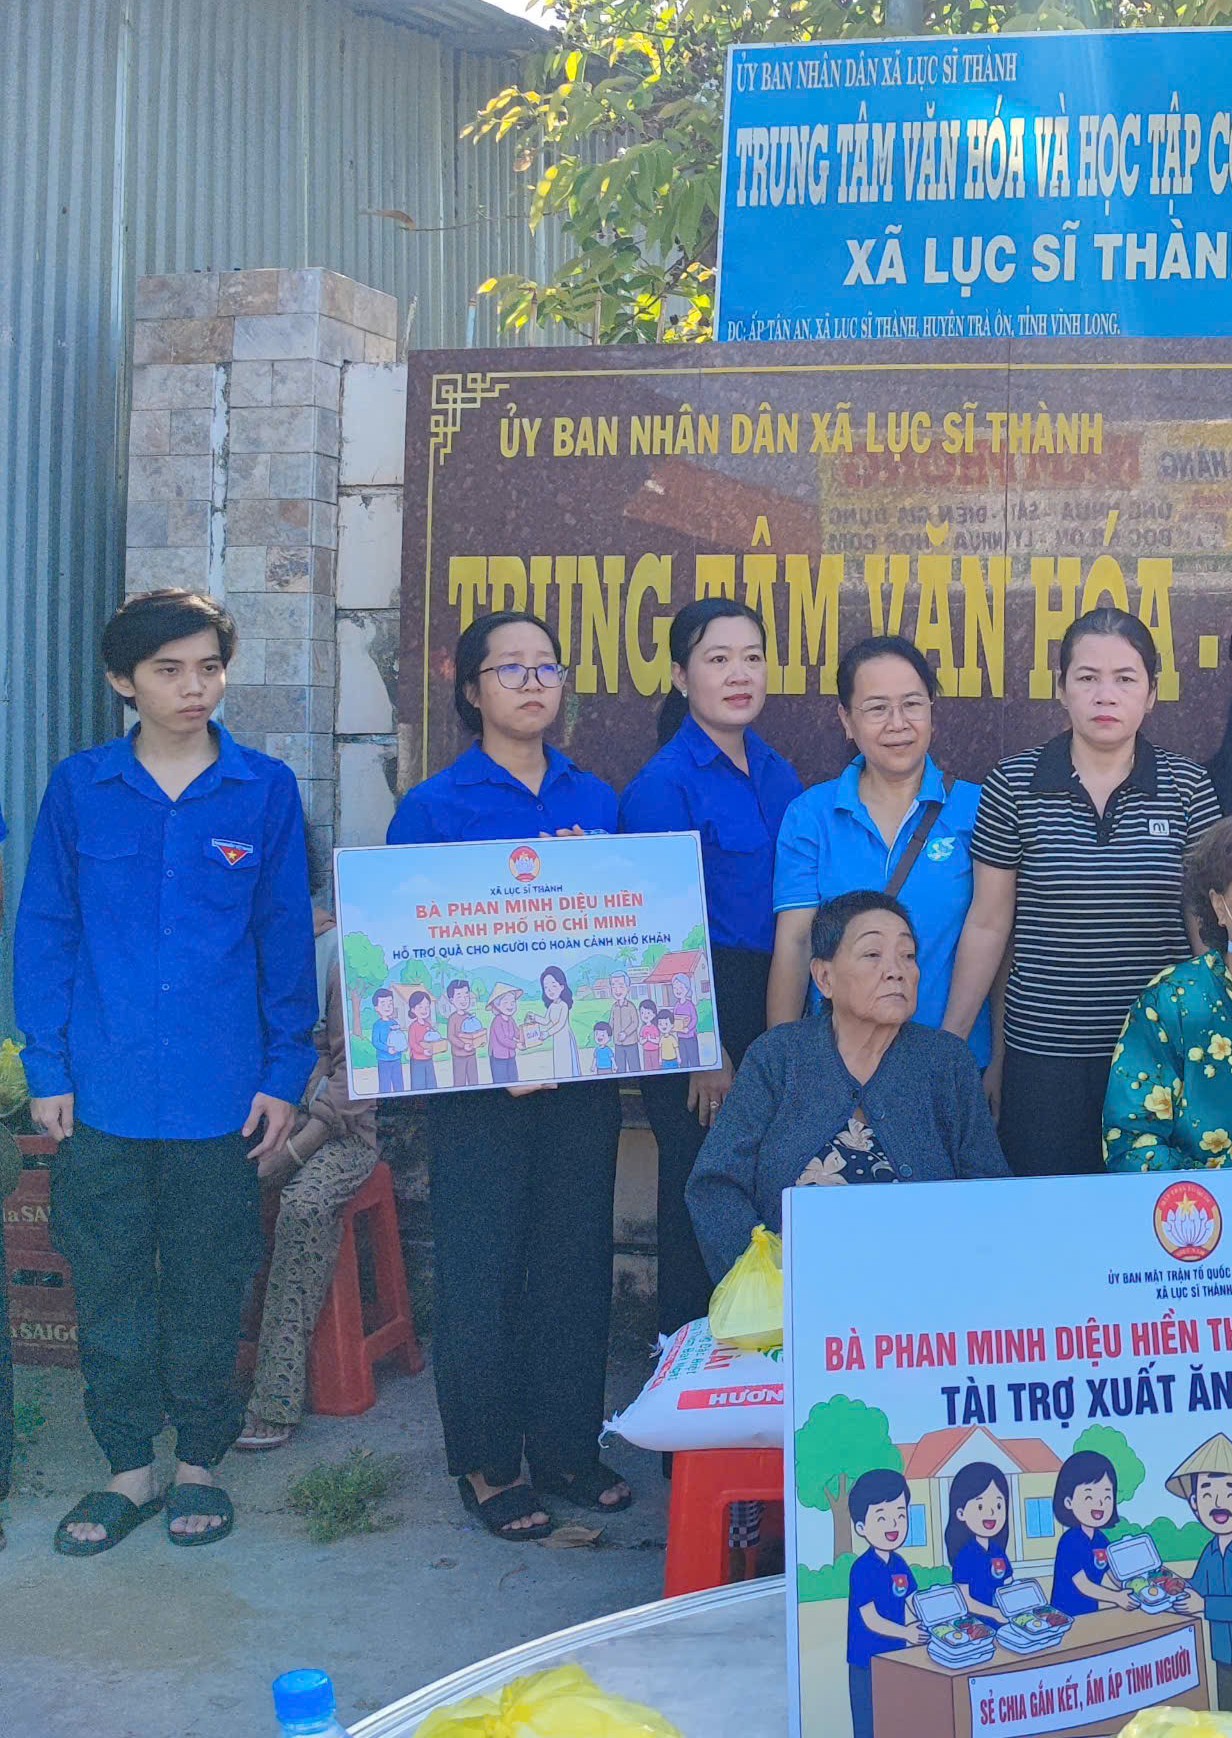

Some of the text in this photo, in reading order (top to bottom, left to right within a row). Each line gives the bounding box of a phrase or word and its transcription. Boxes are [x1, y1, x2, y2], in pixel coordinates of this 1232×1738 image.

[737, 45, 1018, 92] ỦY BAN NHÂN DÂN XÃ LỤC SĨ THÀNH
[736, 124, 830, 207] TRUNG
[837, 100, 897, 204] TÂM
[902, 100, 961, 201] VĂN
[964, 94, 1026, 201] HÓA
[1034, 92, 1070, 199] VÀ
[1077, 113, 1141, 217] HỌC
[1148, 91, 1201, 215] TẬP
[842, 224, 907, 287] XÃ
[924, 235, 1016, 298] LỤC
[1031, 219, 1082, 282] SĨ
[768, 313, 791, 340] TÂN
[815, 313, 830, 339] XÃ
[861, 311, 873, 338] SĨ
[967, 308, 991, 337] TRÀ
[1051, 308, 1081, 335] VĨNH
[1084, 313, 1121, 336] LONG.
[499, 402, 541, 459] ỦY
[553, 416, 619, 457] BAN
[630, 403, 719, 456] NHÂN
[731, 401, 799, 455] DÂN
[810, 401, 853, 453] XÃ
[866, 411, 931, 462] LỤC
[942, 401, 978, 454] SĨ
[986, 400, 1103, 455] THÀNH
[415, 889, 643, 919] BÀ PHAN MINH DIỆU HIỀN
[428, 914, 637, 939] THÀNH PHỐ HỒ CHÍ MINH
[466, 944, 490, 955] CHO
[493, 941, 529, 954] NGƯỜI
[21, 1205, 50, 1223] SA
[1123, 1272, 1142, 1284] BAN
[825, 1327, 866, 1372] BÀ
[875, 1331, 957, 1370] PHAN
[966, 1327, 1046, 1366] MINH
[1055, 1316, 1122, 1367] DIỆU
[1131, 1307, 1201, 1357] HIỀN
[708, 1389, 783, 1406] HƯƠN
[941, 1376, 998, 1426] TÀI
[1007, 1376, 1075, 1428] TRỢ
[1085, 1361, 1176, 1418] XUẤT
[980, 1645, 1192, 1726] SẺ CHIA GẮN KẾT, ẤM ÁP TÌNH NGƯỜI
